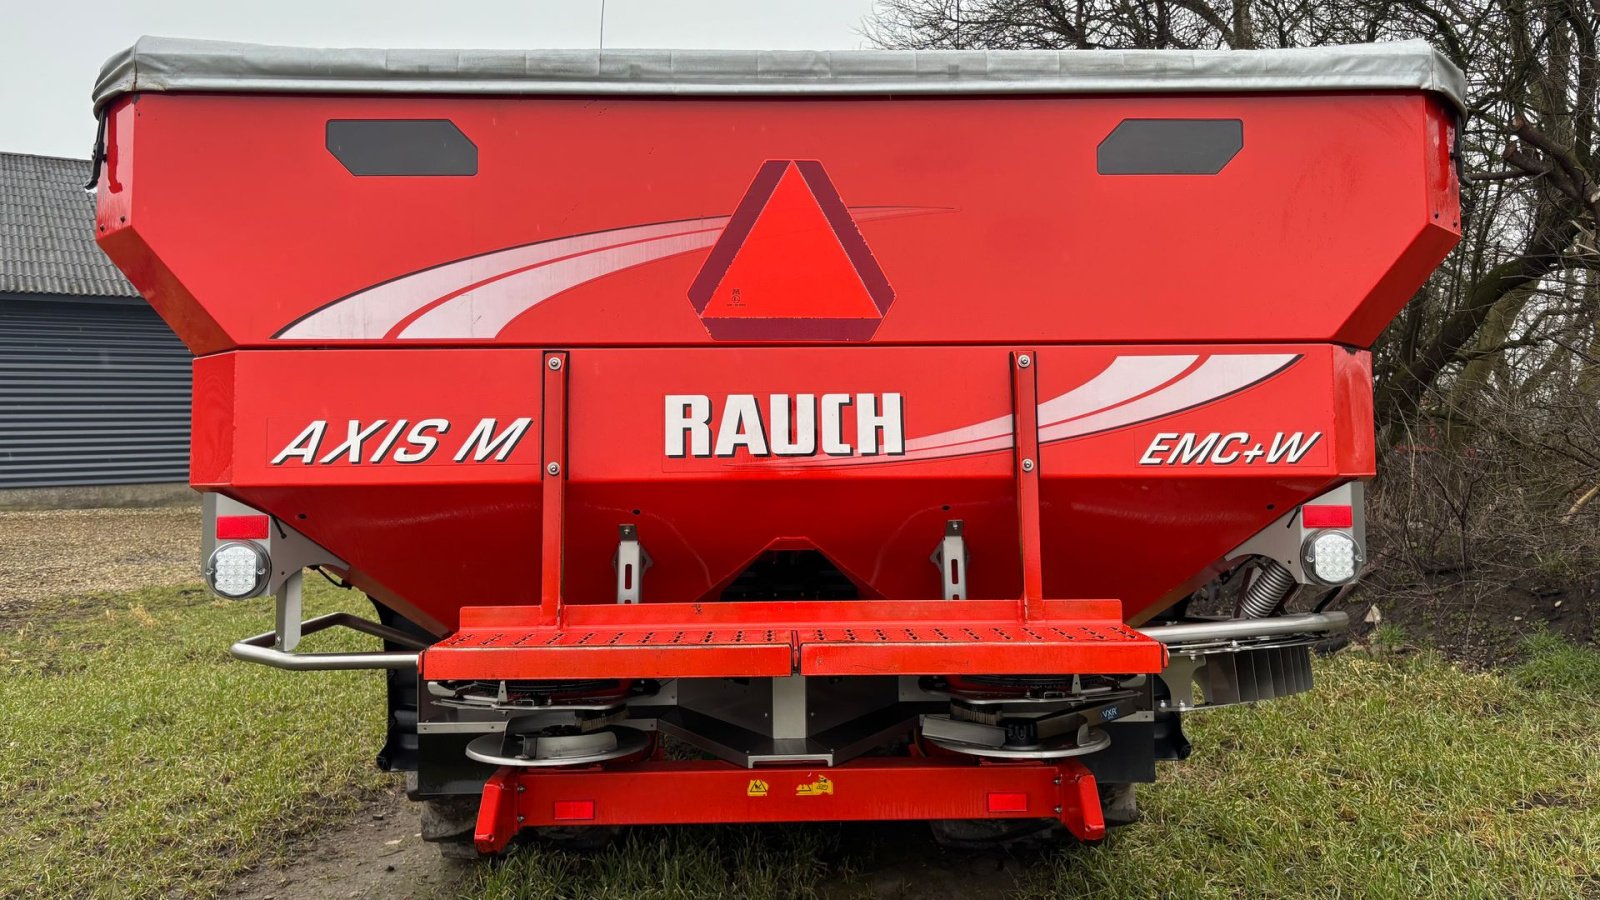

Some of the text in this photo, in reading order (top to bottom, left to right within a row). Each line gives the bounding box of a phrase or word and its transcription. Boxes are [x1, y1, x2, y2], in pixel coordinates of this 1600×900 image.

[270, 417, 533, 465] AXIS M
[665, 393, 905, 458] RAUCH
[1138, 431, 1322, 465] EMC+W
